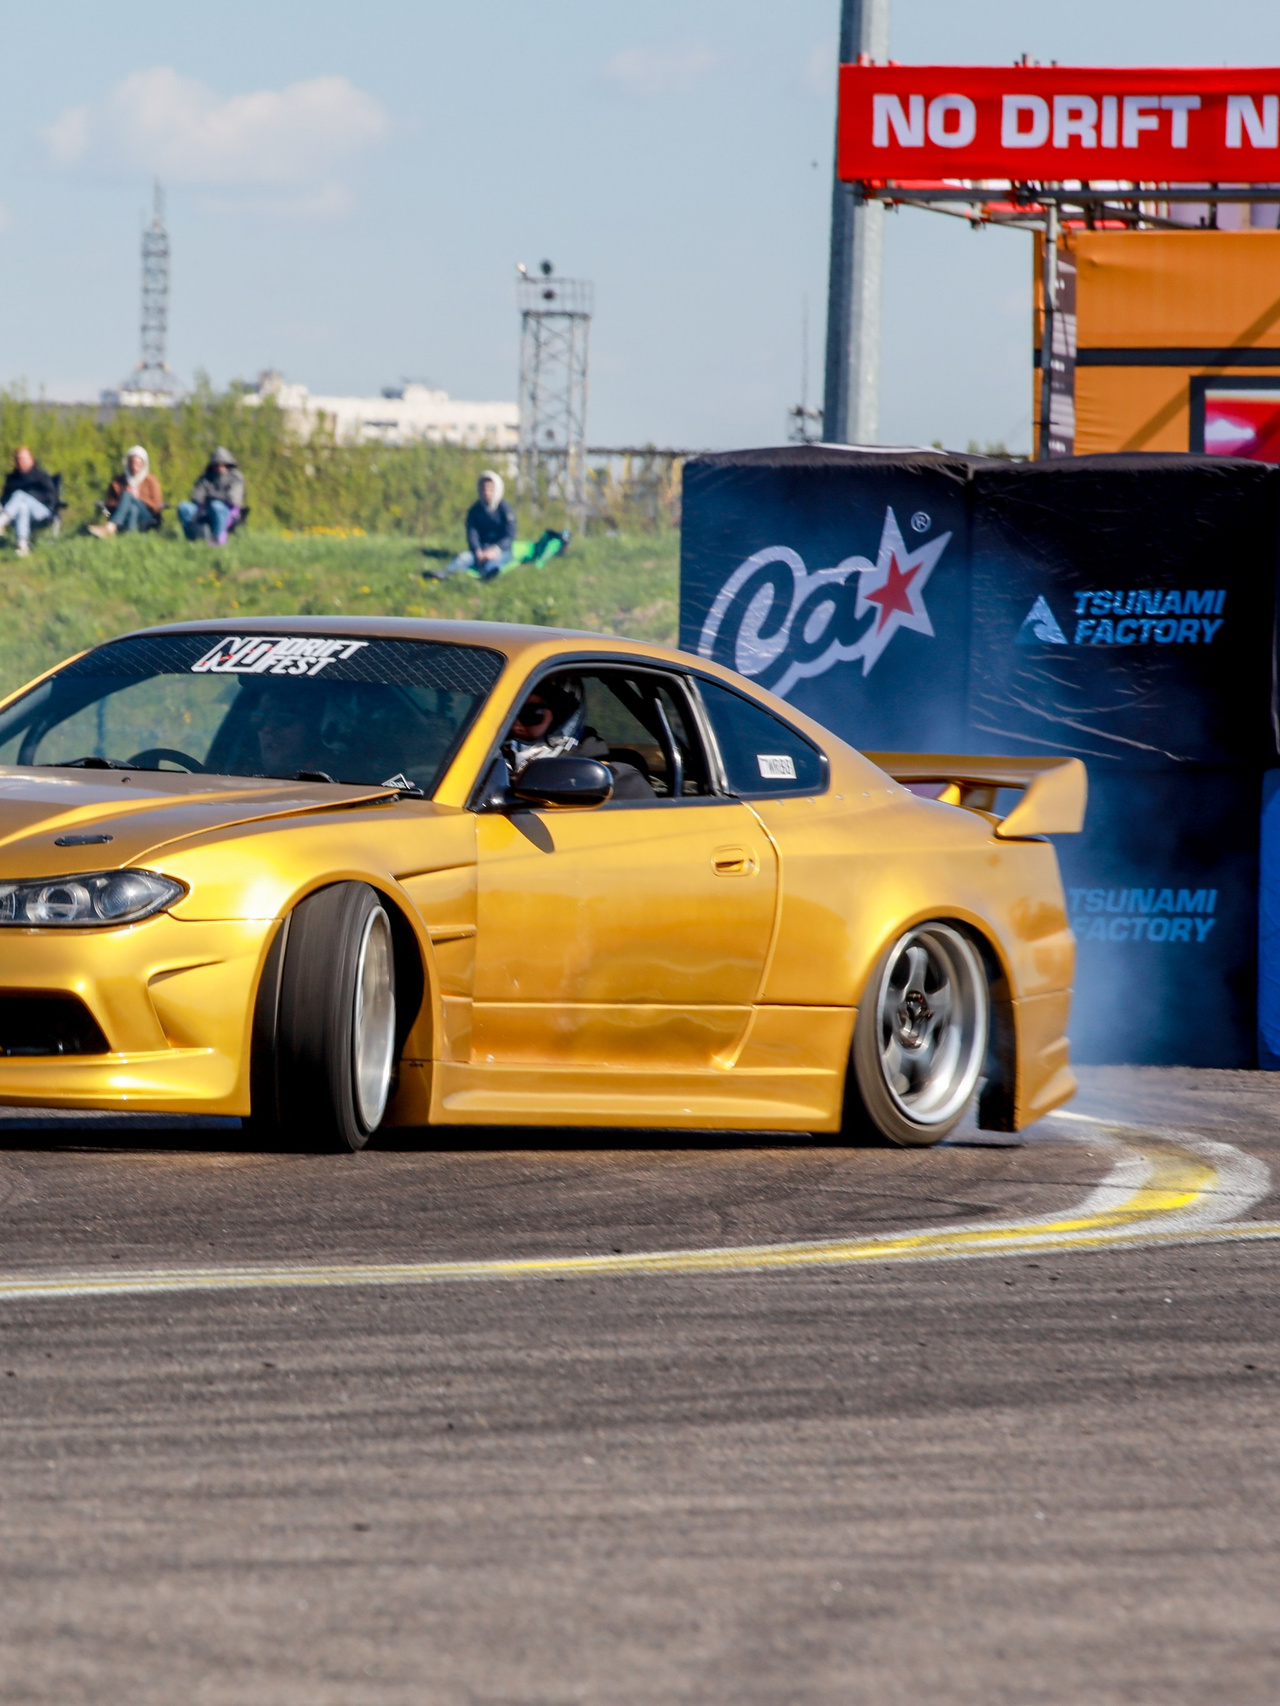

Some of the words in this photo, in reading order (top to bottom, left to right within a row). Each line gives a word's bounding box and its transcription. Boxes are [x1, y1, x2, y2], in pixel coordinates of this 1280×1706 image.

[872, 94, 976, 148] NO
[1001, 94, 1201, 149] DRIFT
[1073, 589, 1227, 615] TSUNAMI
[1073, 618, 1225, 644] FACTORY
[275, 637, 370, 660] DRIFT
[269, 654, 337, 676] FEST
[1067, 887, 1218, 913] TSUNAMI
[1070, 916, 1217, 942] FACTORY
